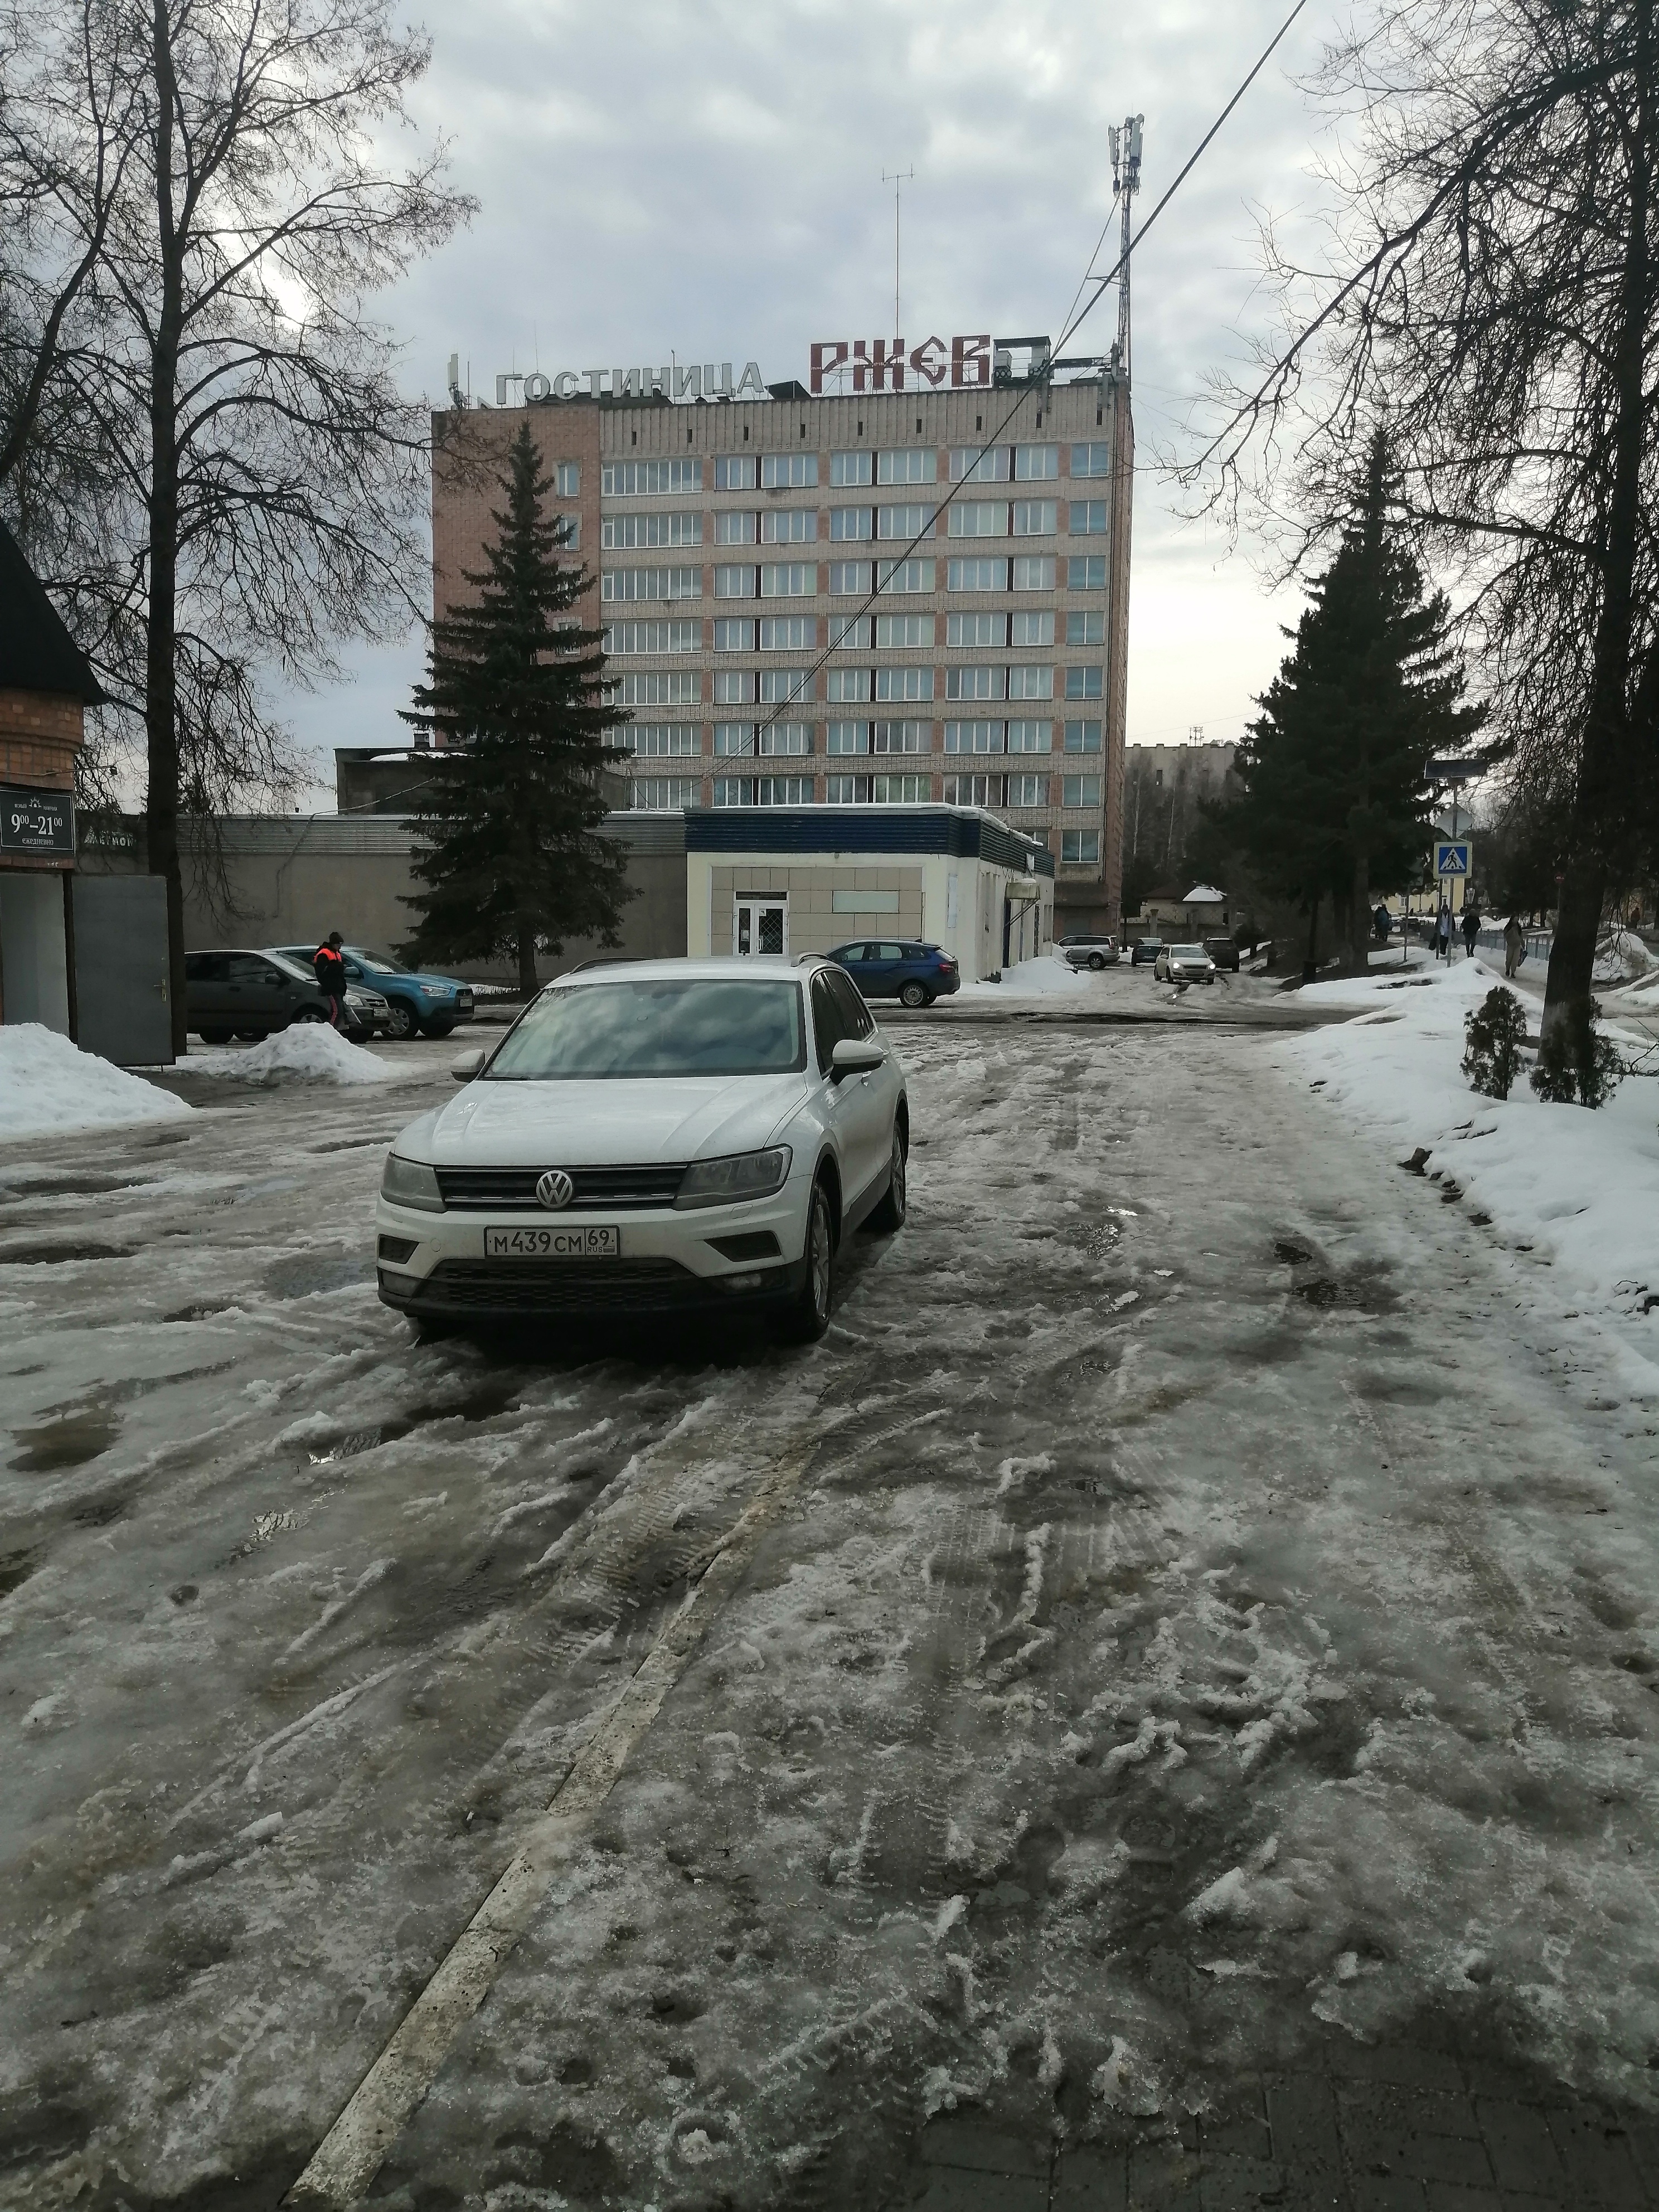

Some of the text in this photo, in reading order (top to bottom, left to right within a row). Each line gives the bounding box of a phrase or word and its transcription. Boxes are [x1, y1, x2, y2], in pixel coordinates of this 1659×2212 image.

[496, 335, 991, 404] ГОСТИНИЦА РЖЕВ
[588, 1230, 609, 1246] 69
